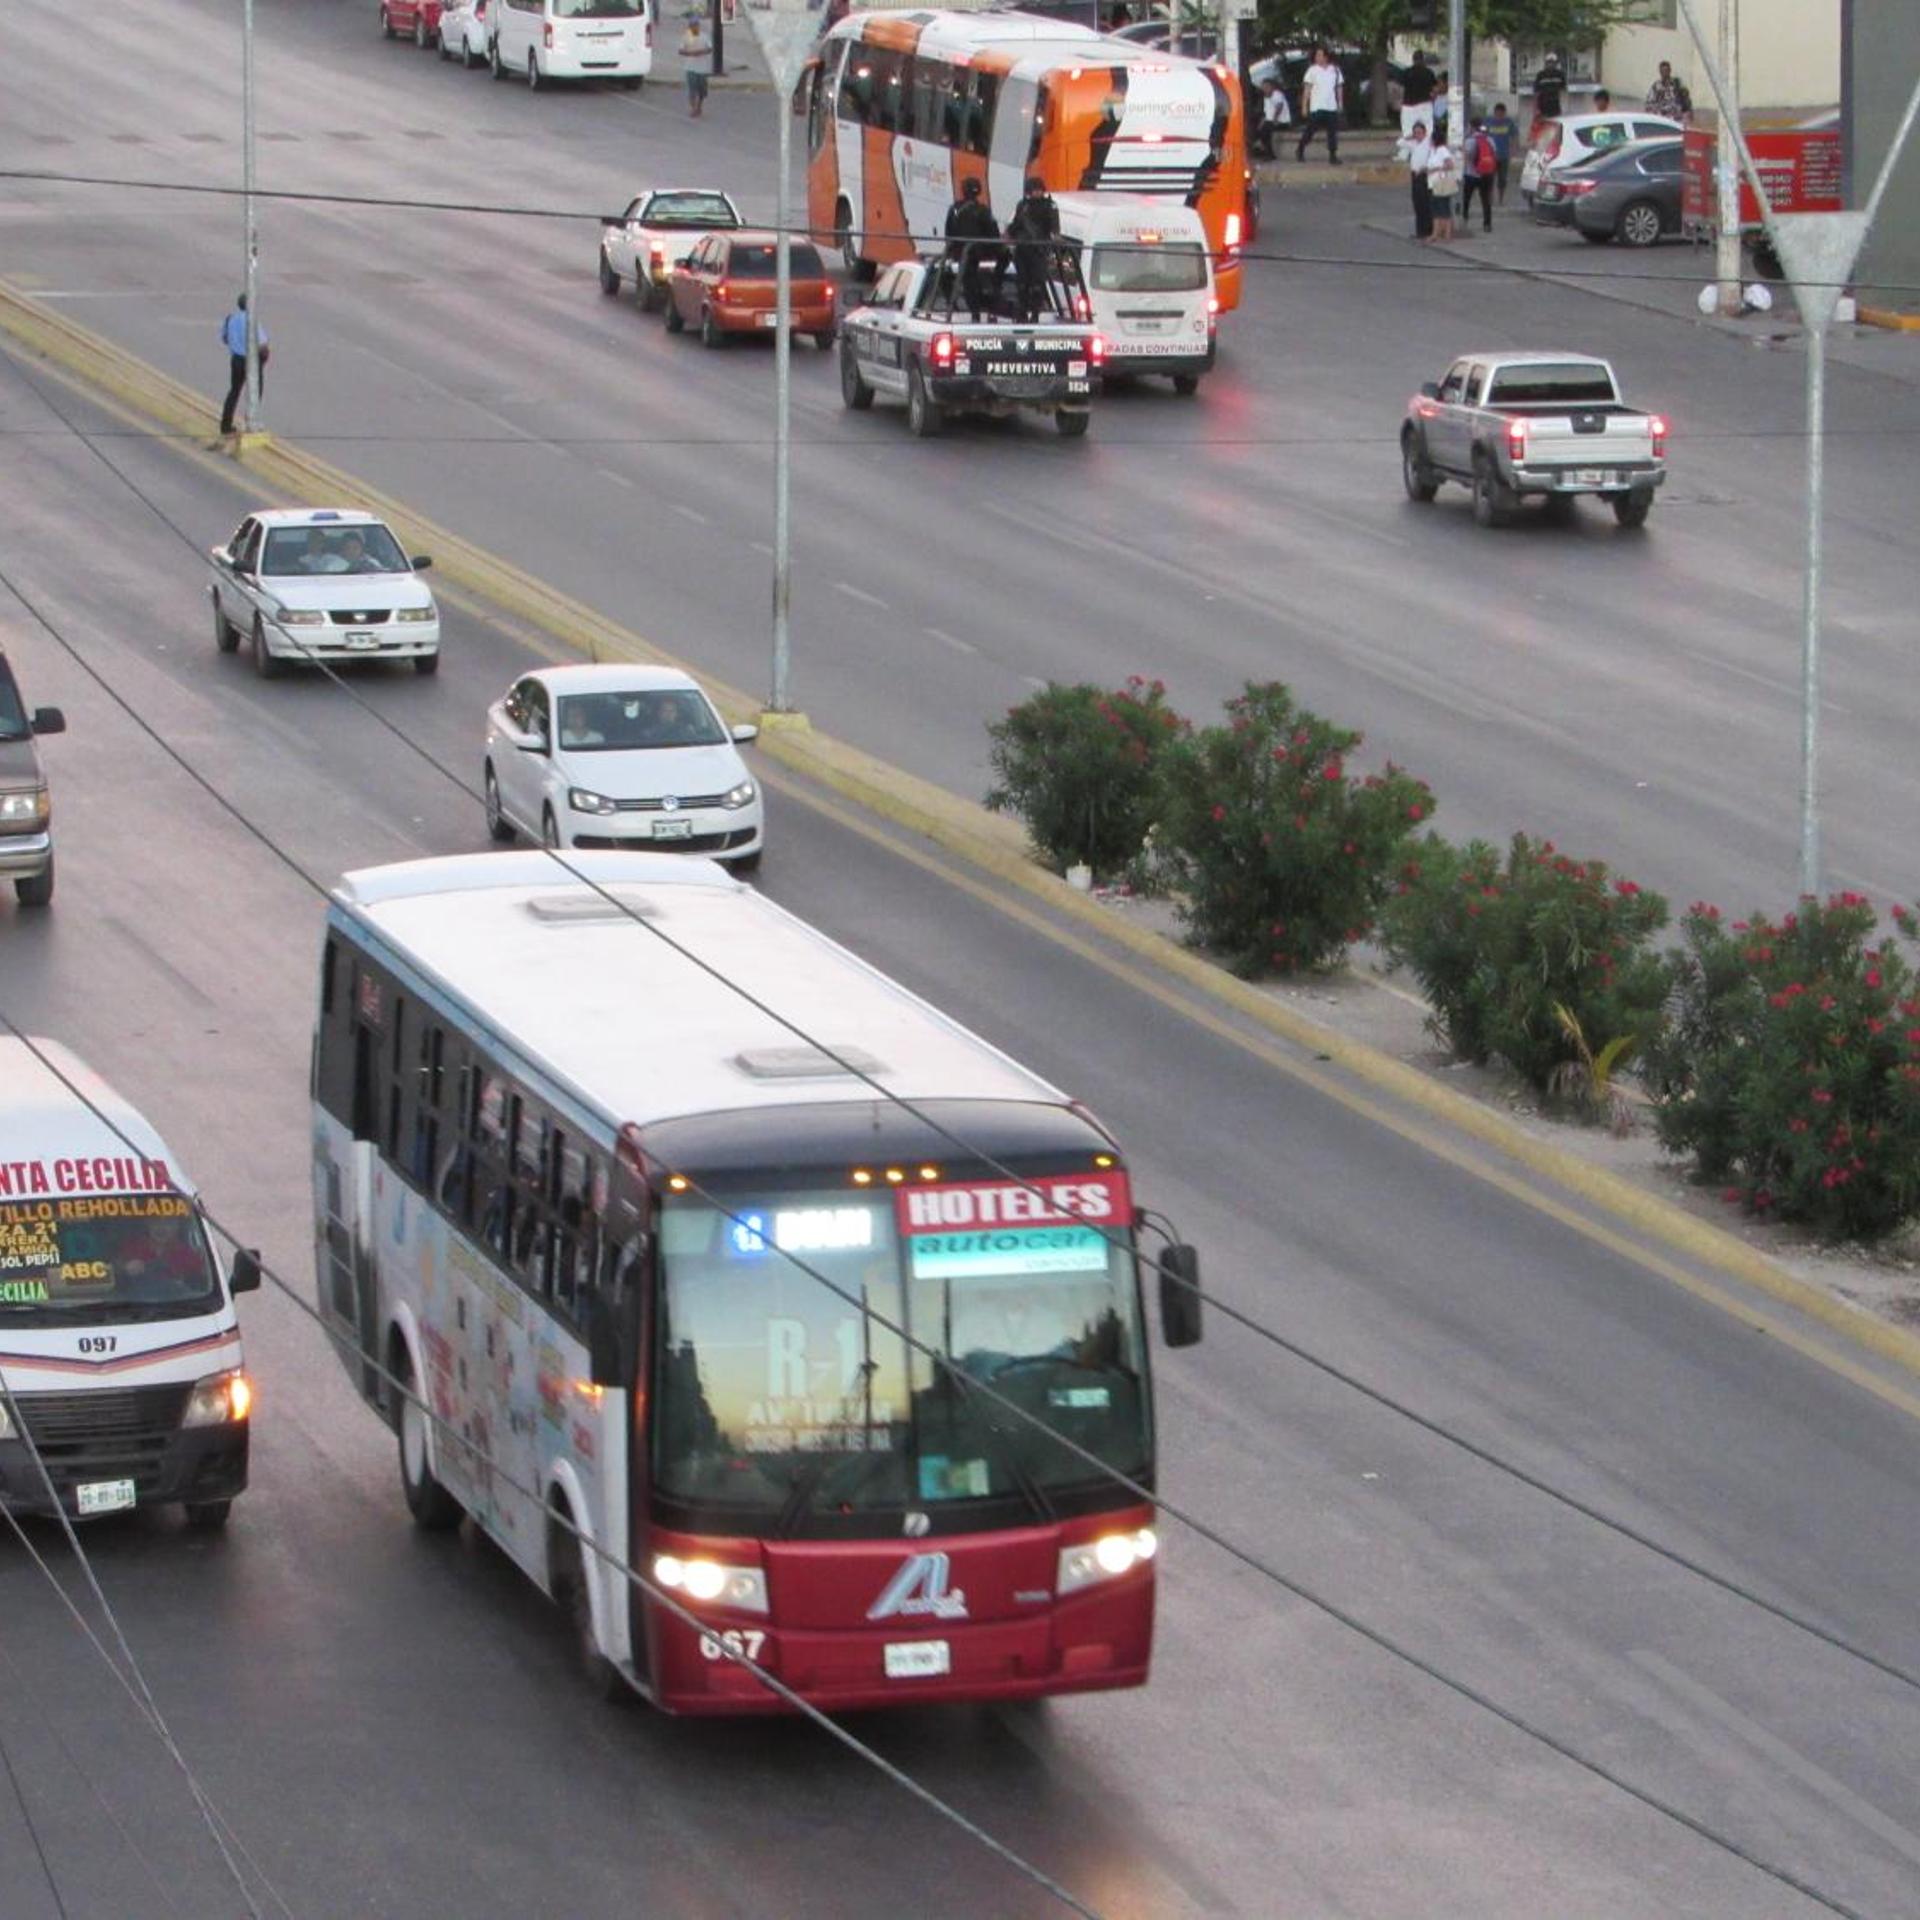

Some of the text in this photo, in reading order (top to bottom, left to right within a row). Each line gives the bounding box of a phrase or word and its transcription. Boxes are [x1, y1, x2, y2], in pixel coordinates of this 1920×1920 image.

[1034, 339, 1083, 351] MUNICIPAL
[987, 362, 1056, 375] PREVENTIVA
[54, 1156, 173, 1192] CECILIA
[58, 1198, 190, 1218] REHOLLADA
[908, 1184, 1111, 1226] HOTELES
[34, 1221, 57, 1235] 21
[917, 1226, 1102, 1254] autocar
[61, 1261, 107, 1280] ABC
[78, 1336, 117, 1353] 097
[768, 1318, 858, 1397] R-1
